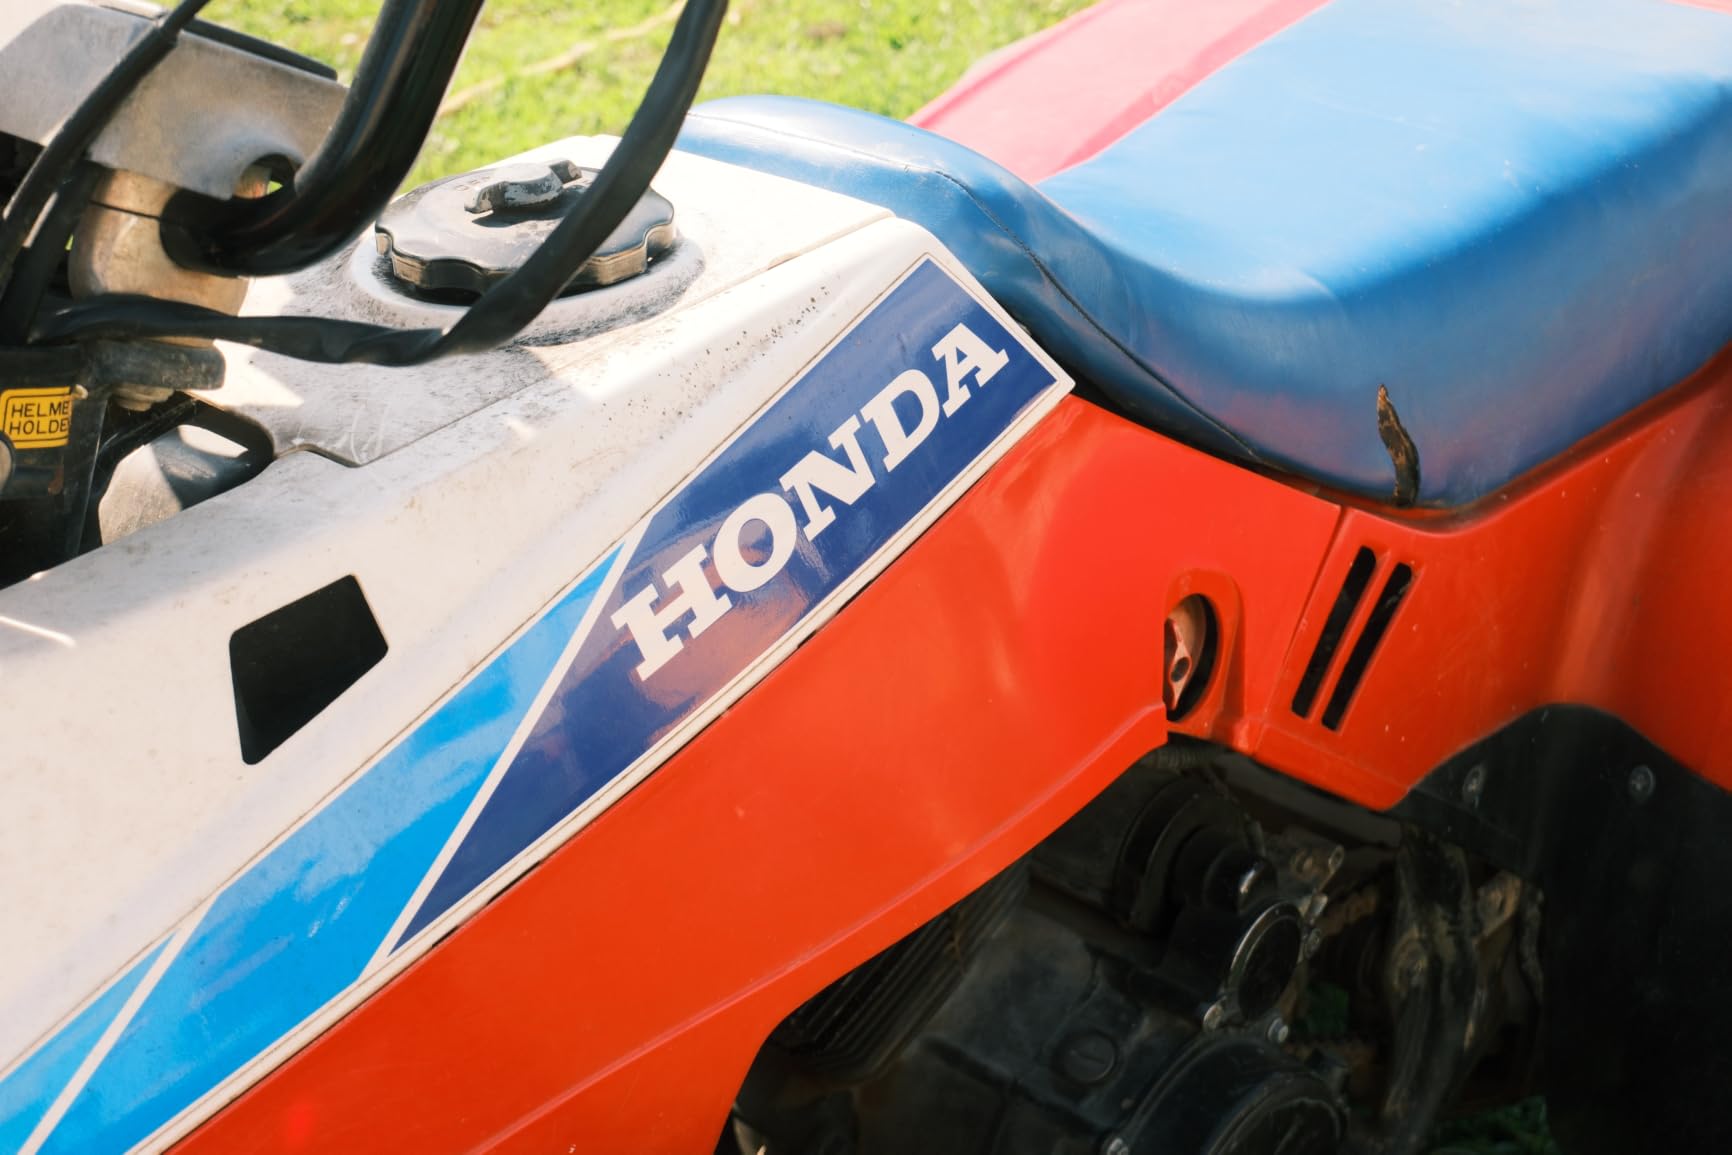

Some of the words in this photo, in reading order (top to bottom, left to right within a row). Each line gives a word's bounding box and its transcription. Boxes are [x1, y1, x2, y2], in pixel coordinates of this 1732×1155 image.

[11, 400, 70, 418] HELME
[9, 417, 70, 435] HOLDE
[610, 322, 1010, 682] HONDA
